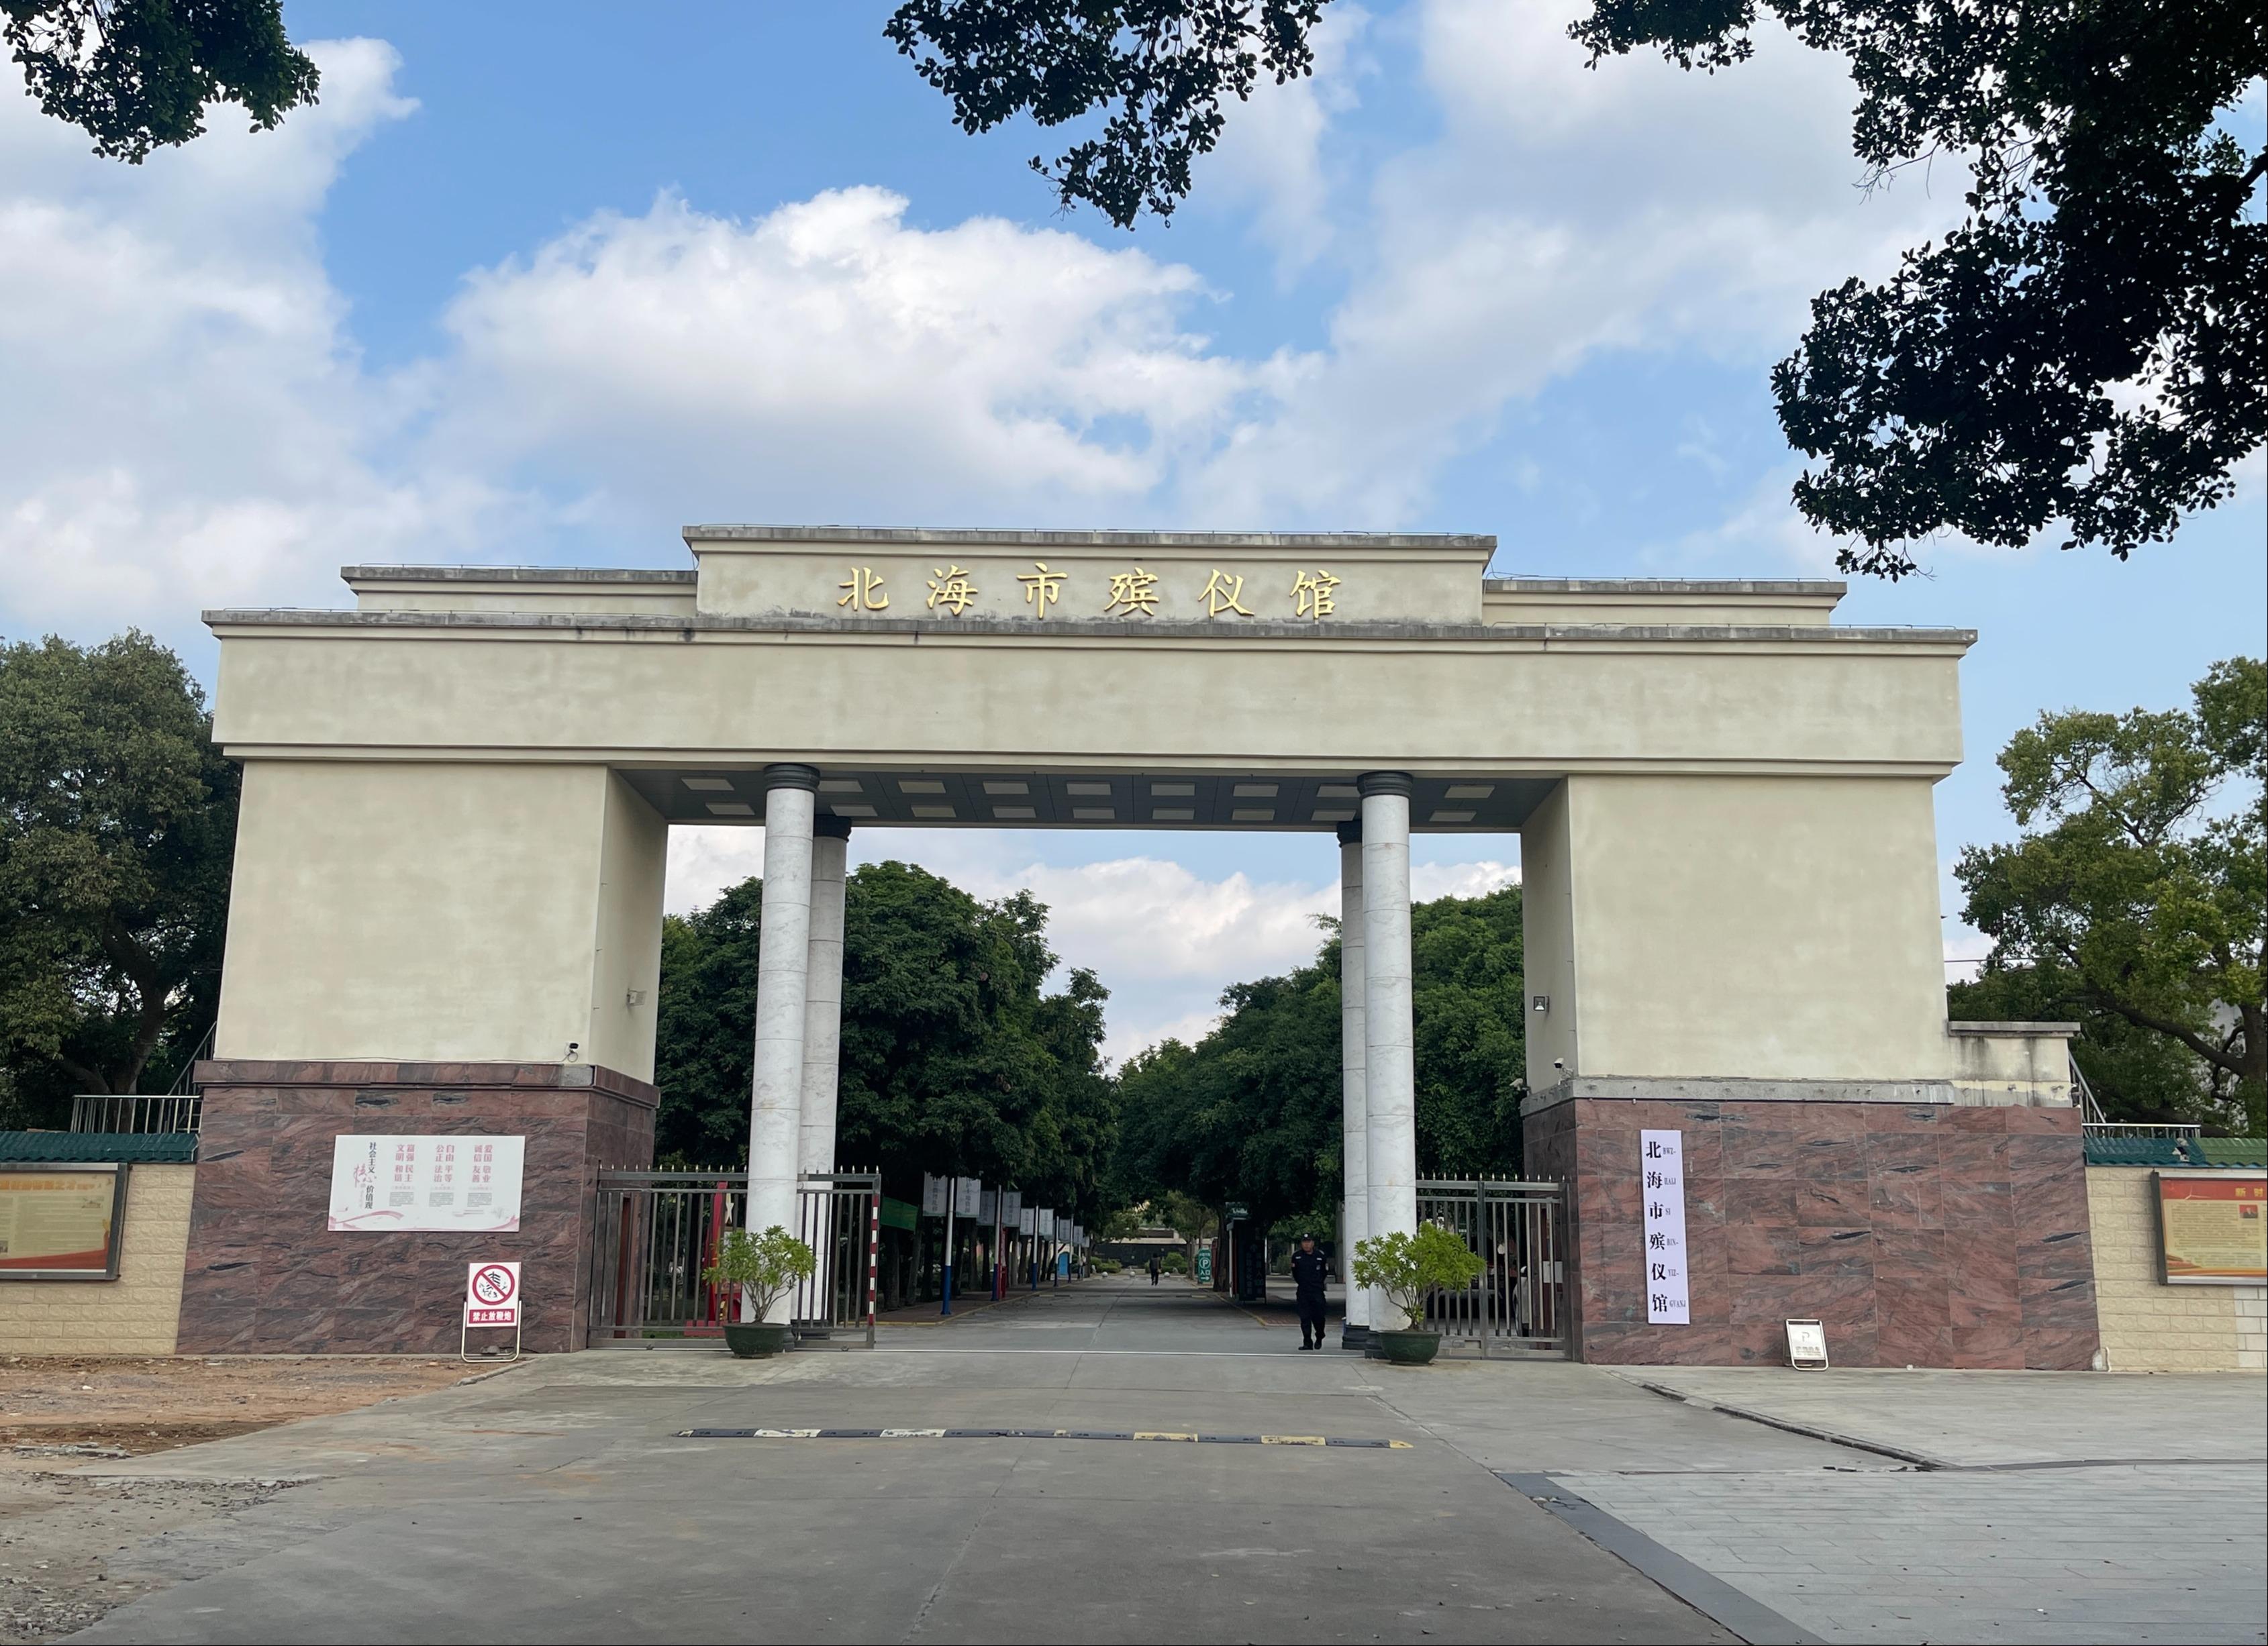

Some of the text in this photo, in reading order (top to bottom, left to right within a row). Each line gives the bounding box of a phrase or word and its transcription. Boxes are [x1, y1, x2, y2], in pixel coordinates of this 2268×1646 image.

[838, 562, 1341, 619] 北海市殡仪馆
[368, 1142, 377, 1174] 社会主义
[365, 1185, 374, 1209] 价值观
[1646, 1141, 1668, 1313] 北海市殡仪馆
[473, 1311, 511, 1321] 禁止放鞭炮
